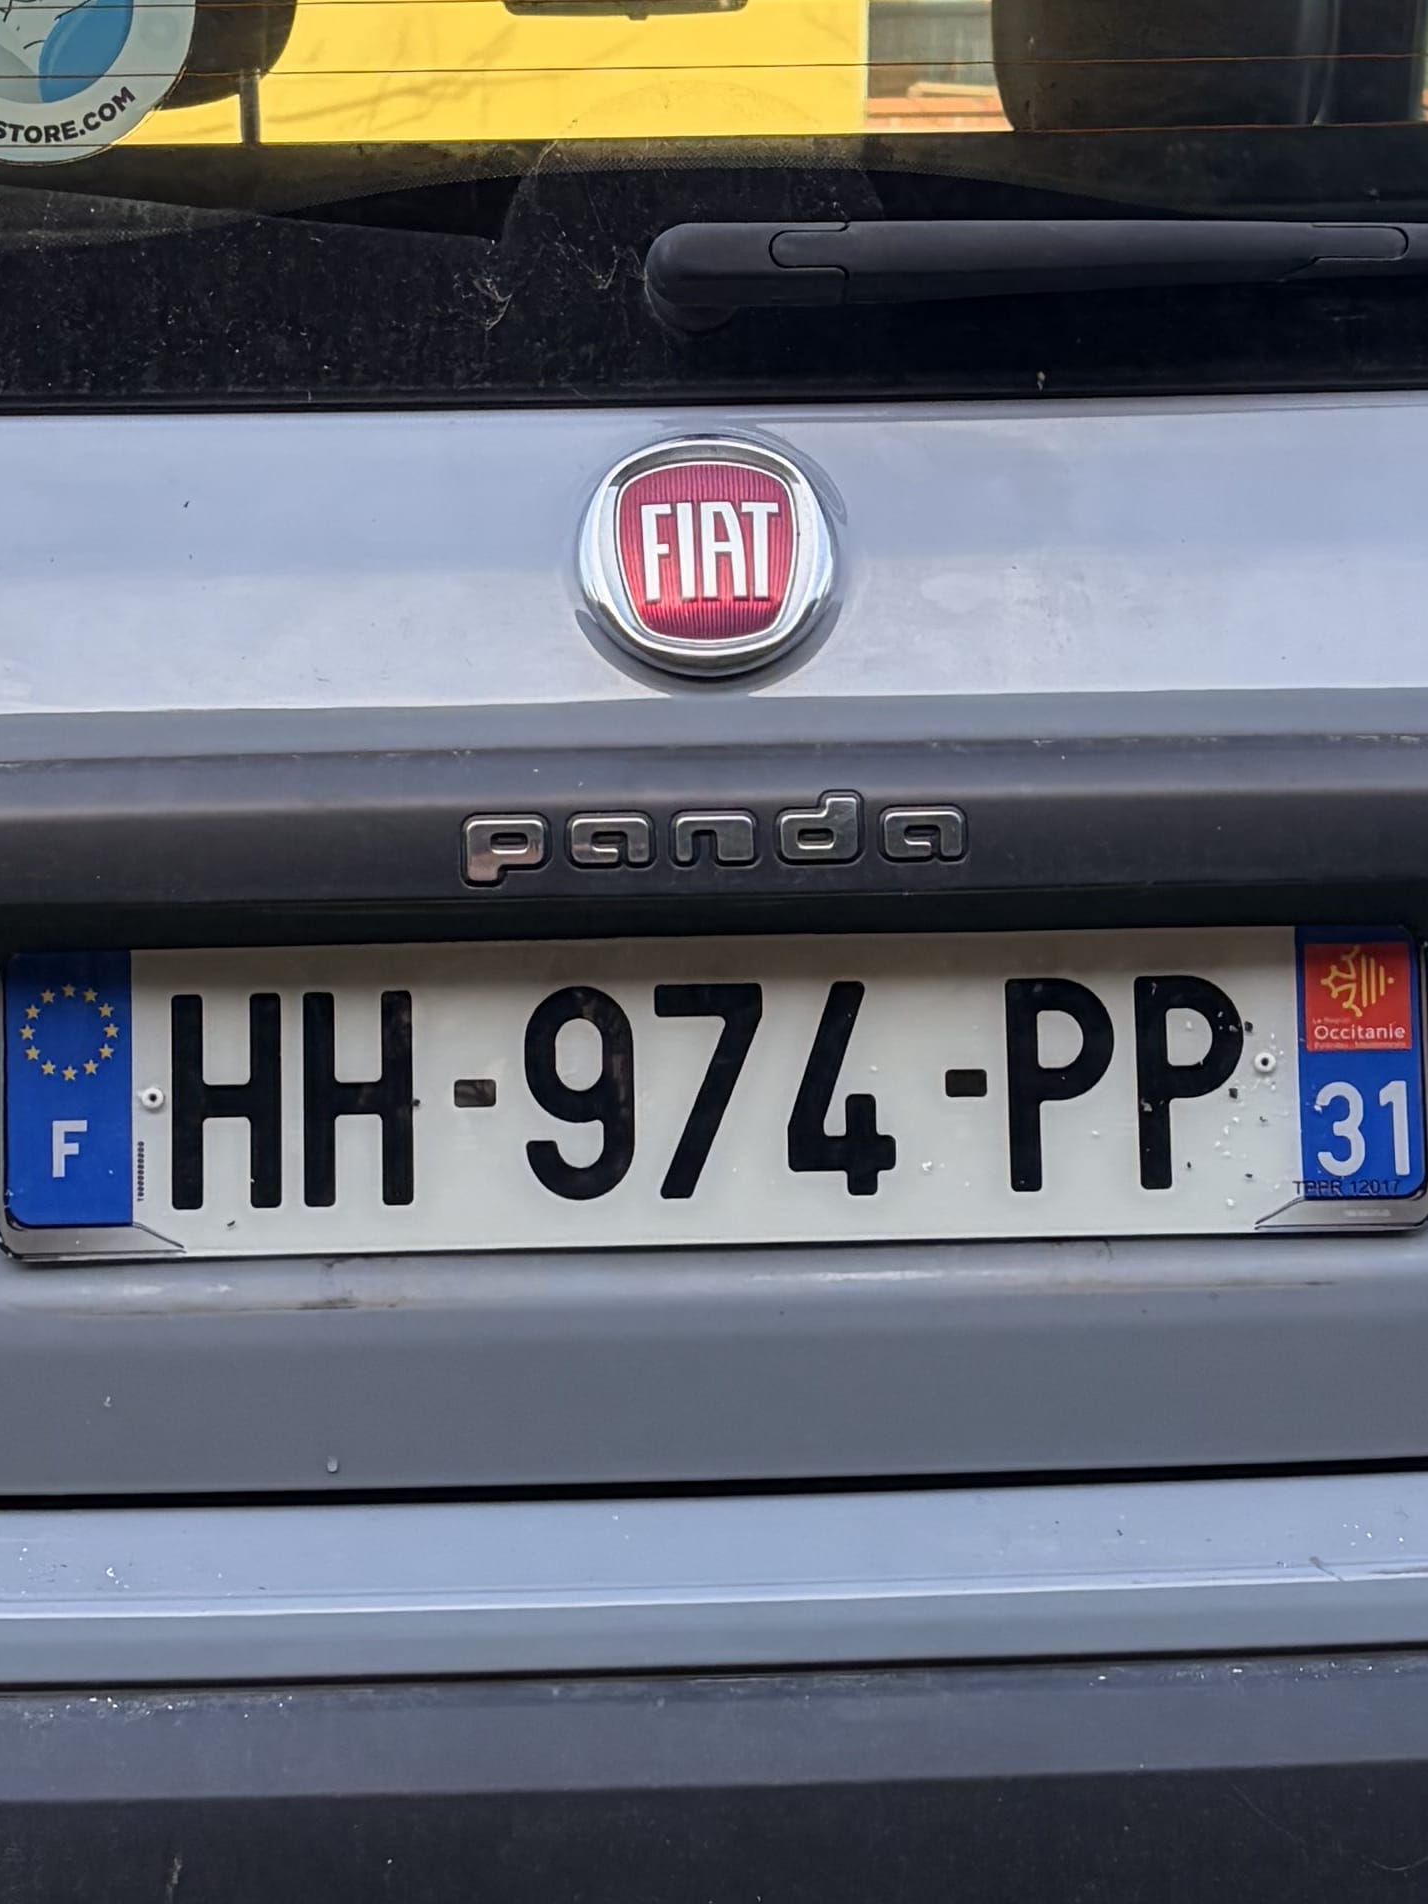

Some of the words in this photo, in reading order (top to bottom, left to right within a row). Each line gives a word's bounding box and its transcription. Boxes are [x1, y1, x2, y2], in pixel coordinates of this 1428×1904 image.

[641, 501, 779, 602] FIAT
[464, 794, 964, 884] panda
[1314, 1022, 1406, 1040] Occitanie
[171, 976, 1243, 1209] HH-974-PP
[1315, 1080, 1411, 1177] 31
[52, 1119, 88, 1178] F
